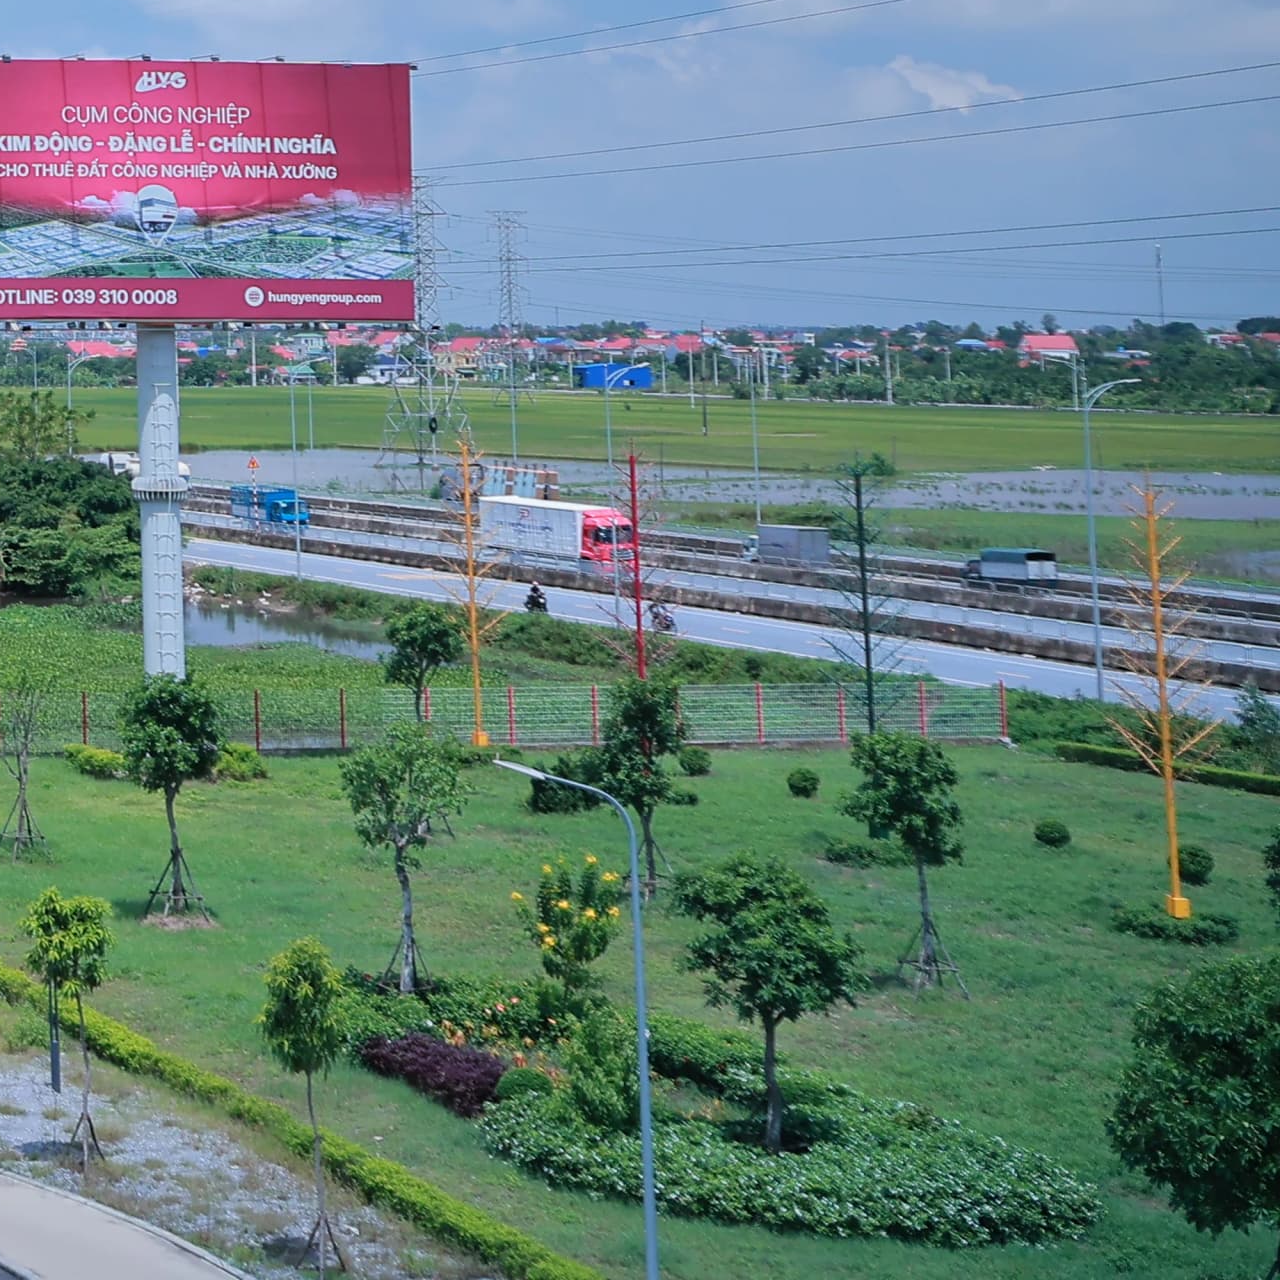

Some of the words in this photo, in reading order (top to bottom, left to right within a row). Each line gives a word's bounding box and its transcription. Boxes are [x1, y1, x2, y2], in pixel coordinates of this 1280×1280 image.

[136, 71, 187, 92] HYG
[61, 106, 108, 127] CỤM
[113, 102, 173, 124] CÔNG
[177, 102, 250, 128] NGHIỆP
[33, 131, 92, 156] ĐỘNG
[107, 131, 168, 156] ĐẶNG
[170, 129, 194, 152] LỄ
[208, 133, 272, 153] CHÍNH
[273, 134, 337, 155] NGHĨA
[32, 160, 75, 177] THUÊ
[76, 158, 109, 178] ĐẤT
[111, 160, 158, 178] CÔNG
[160, 161, 218, 181] NGHIỆP
[221, 161, 243, 178] VÀ
[244, 161, 279, 179] NHÀ
[62, 288, 96, 305] 039
[98, 288, 129, 305] 310
[132, 288, 178, 305] 0008
[267, 291, 382, 306] hungyengroup.com
